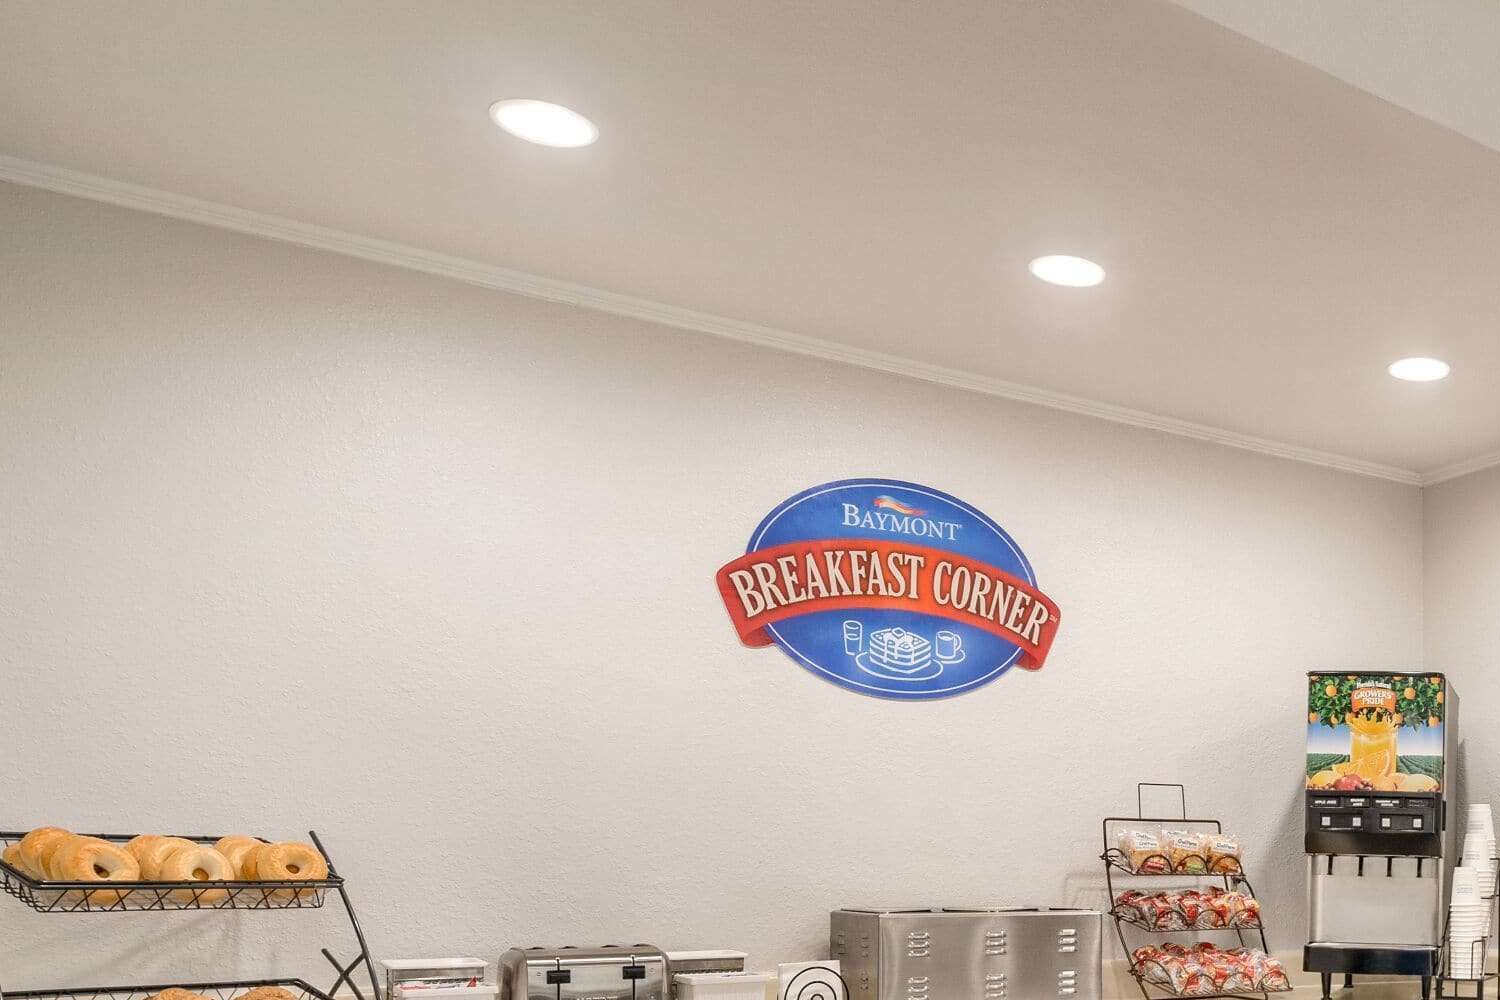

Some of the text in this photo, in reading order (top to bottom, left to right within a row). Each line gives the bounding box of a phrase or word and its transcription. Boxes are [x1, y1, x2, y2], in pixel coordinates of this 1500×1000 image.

[842, 503, 959, 541] BAYMONT
[729, 550, 1050, 646] BREAKFAST CORNER
